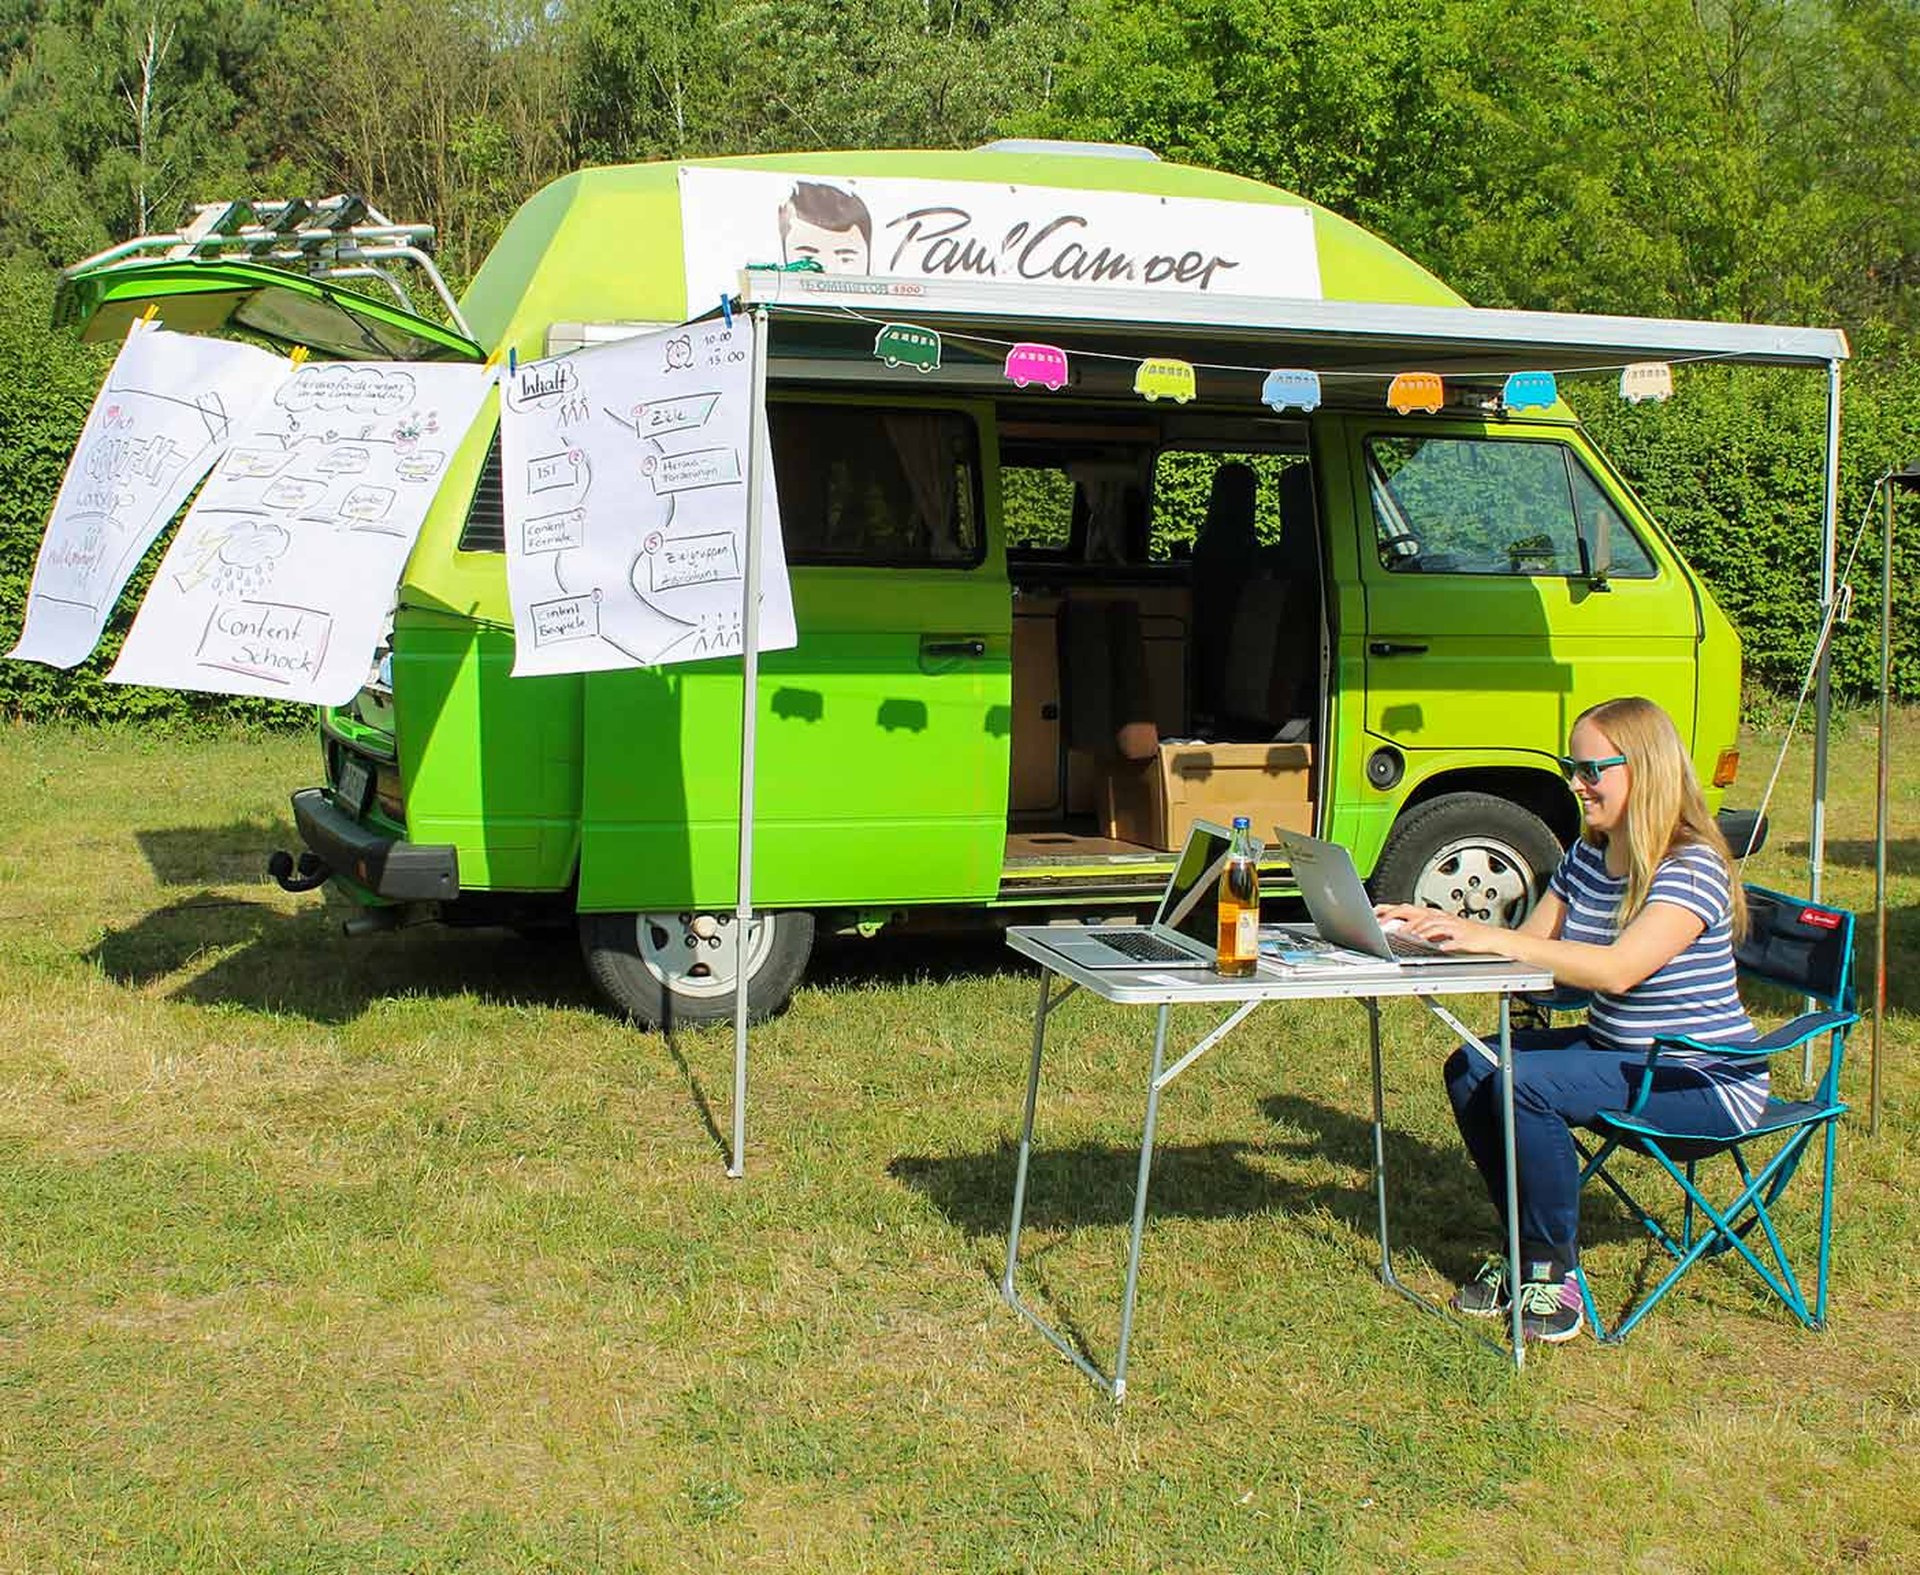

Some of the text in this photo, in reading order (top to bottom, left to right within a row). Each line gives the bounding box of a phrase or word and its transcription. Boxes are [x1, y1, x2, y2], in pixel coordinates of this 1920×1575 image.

[521, 369, 568, 396] Inhalt
[217, 608, 304, 641] Content
[231, 646, 316, 672] Schock
